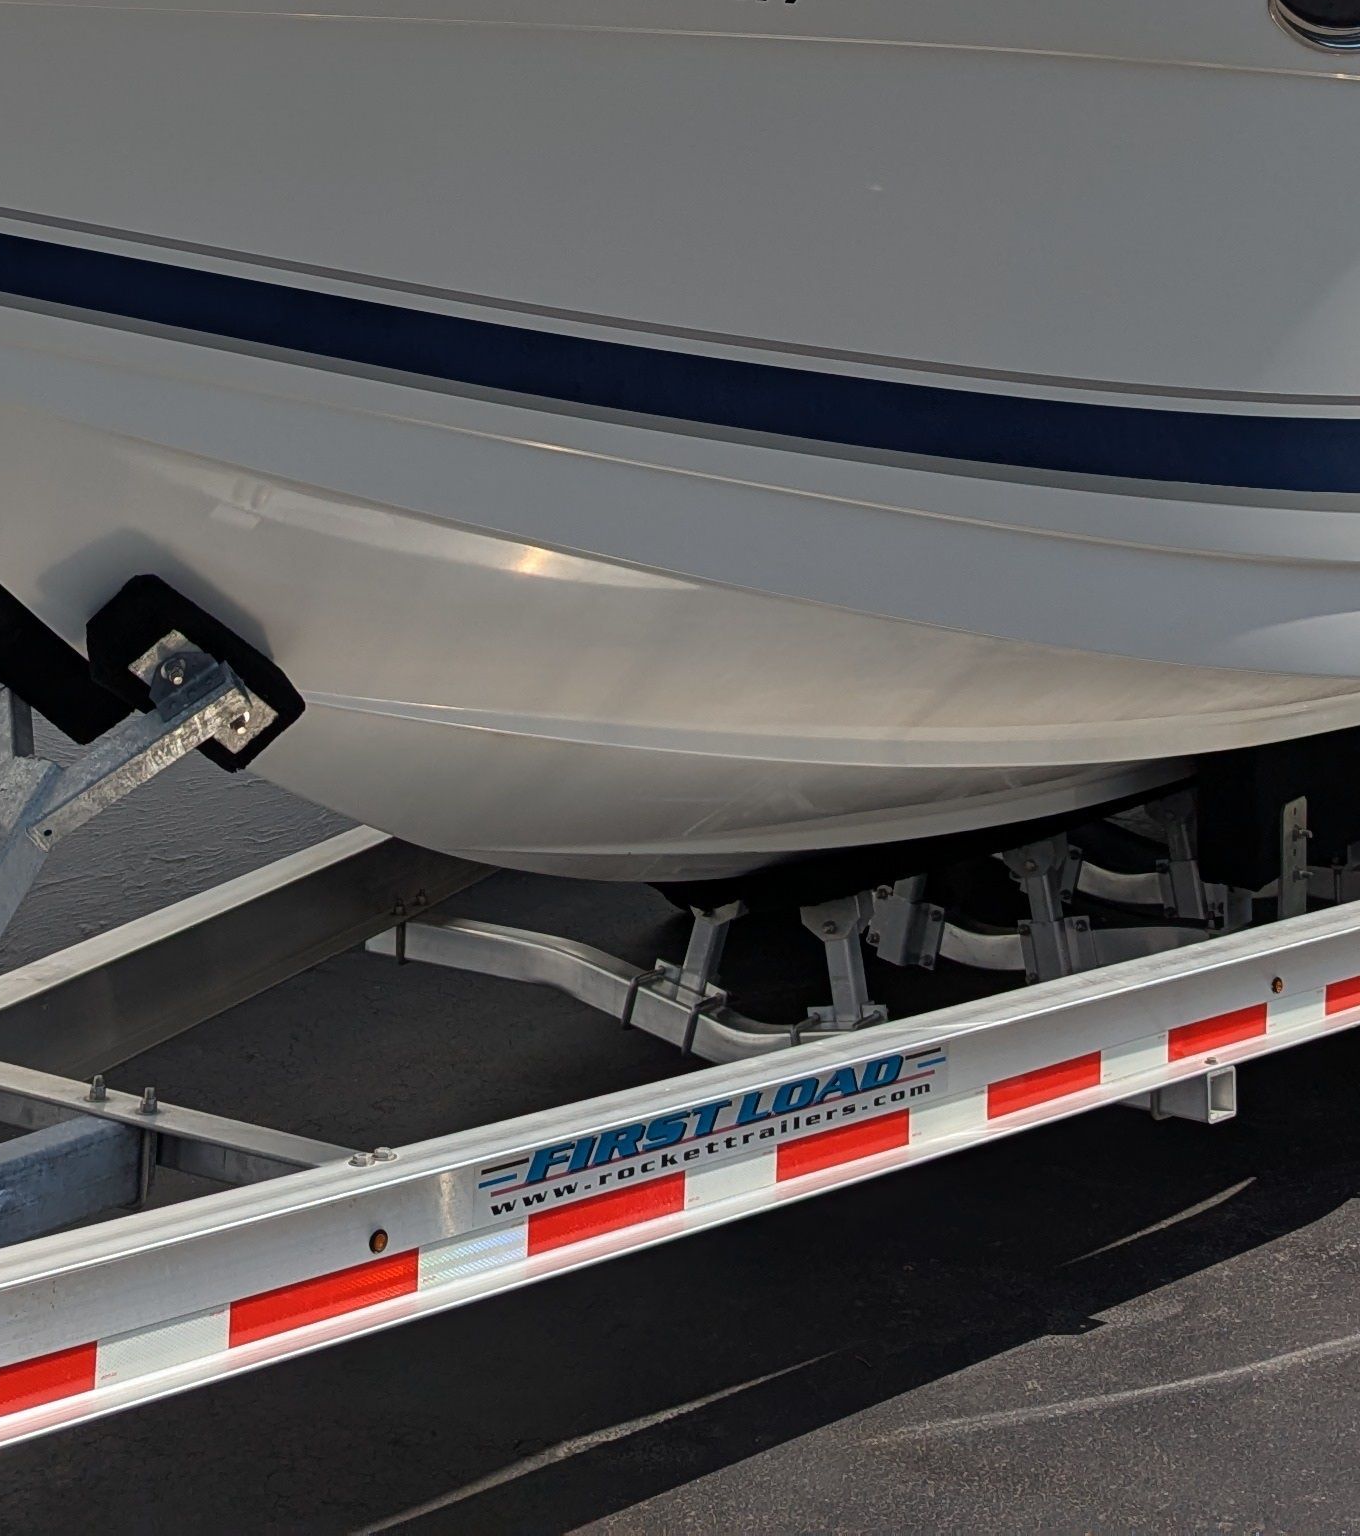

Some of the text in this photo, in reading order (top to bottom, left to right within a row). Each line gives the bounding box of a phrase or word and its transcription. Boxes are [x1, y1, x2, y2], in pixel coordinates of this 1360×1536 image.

[490, 1082, 932, 1216] www.rockettrailers.com
[525, 1055, 904, 1183] FIRST LOAD
